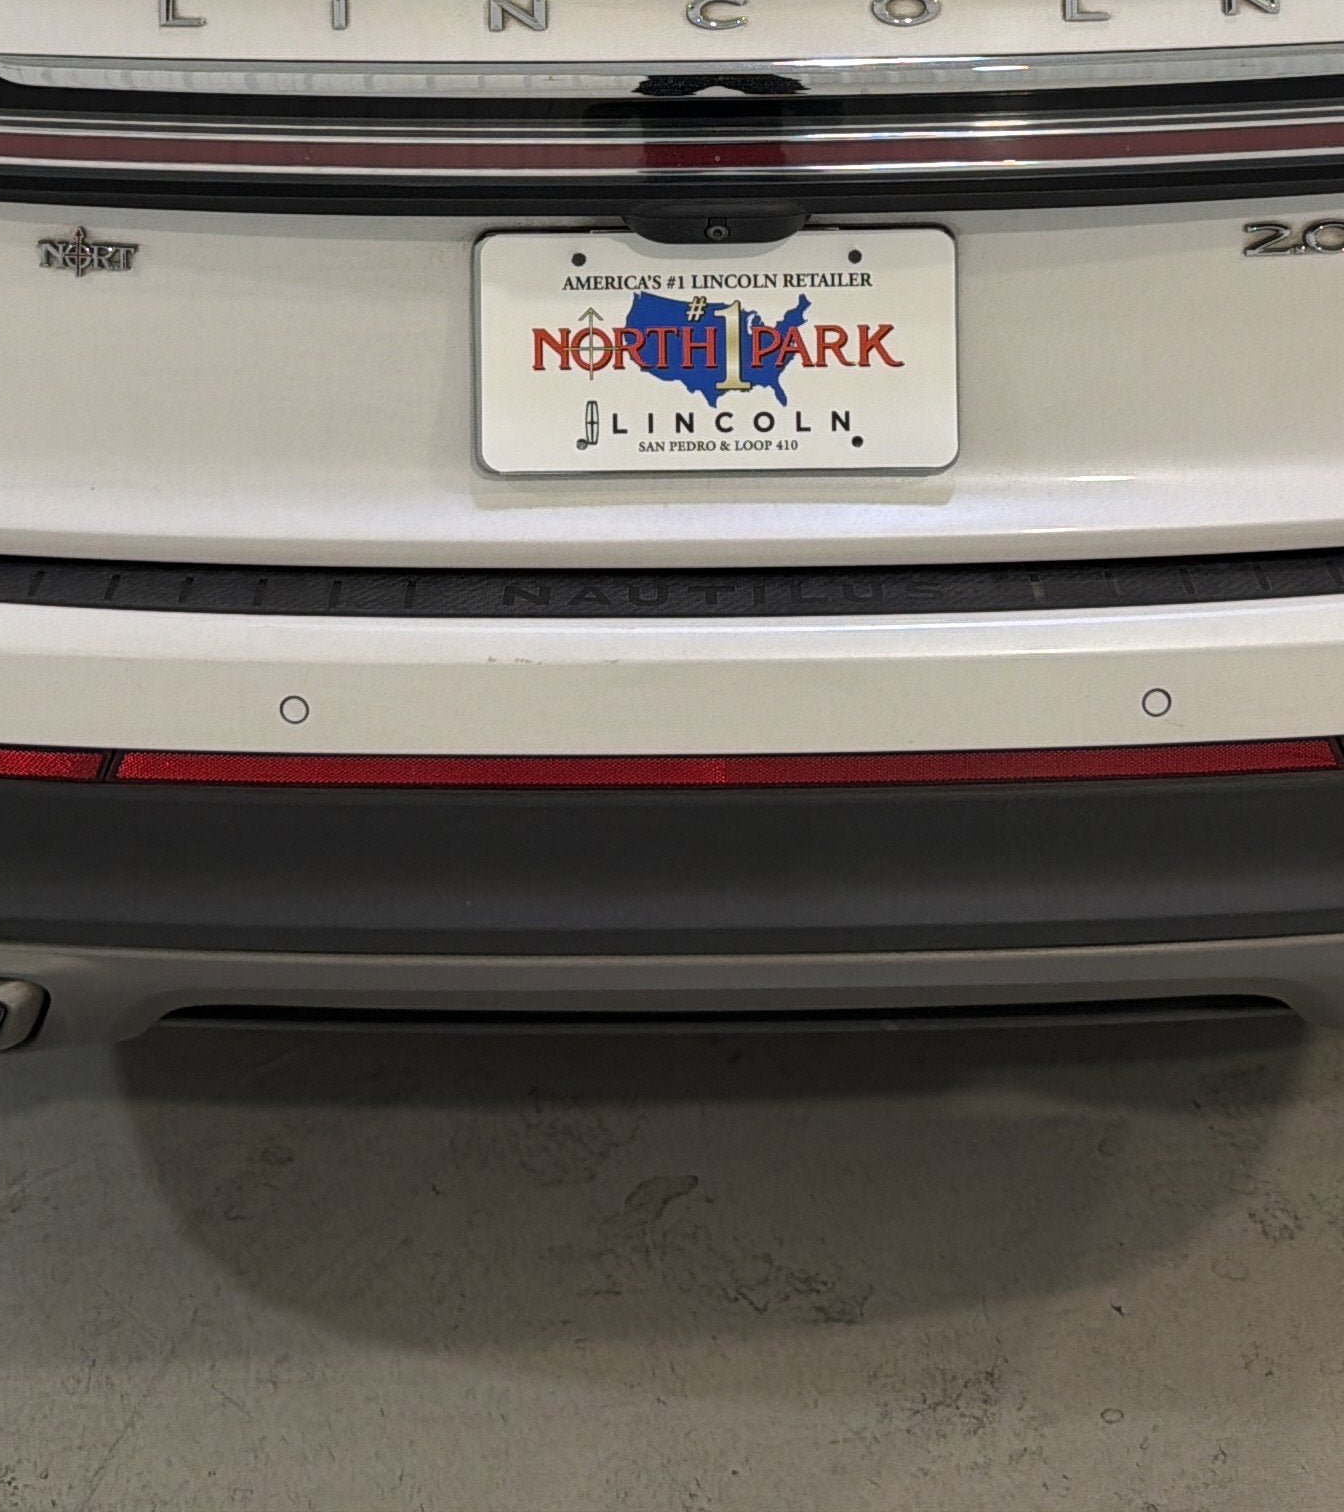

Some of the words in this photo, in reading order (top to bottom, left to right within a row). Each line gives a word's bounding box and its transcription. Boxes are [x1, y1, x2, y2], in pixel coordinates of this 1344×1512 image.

[38, 239, 139, 270] NORT
[562, 274, 662, 290] AMERICA'S
[666, 274, 685, 289] #1
[691, 273, 777, 289] LINCOLN
[782, 272, 873, 288] RETAILER
[532, 325, 717, 372] NORTH
[750, 324, 905, 368] PARK
[612, 410, 851, 435] LINCOLN
[638, 440, 665, 453] SAN
[669, 440, 716, 452] PEDRO
[719, 440, 731, 452] &
[734, 439, 772, 452] LOOP
[775, 439, 799, 451] 410
[502, 579, 945, 606] NAUTILUS
